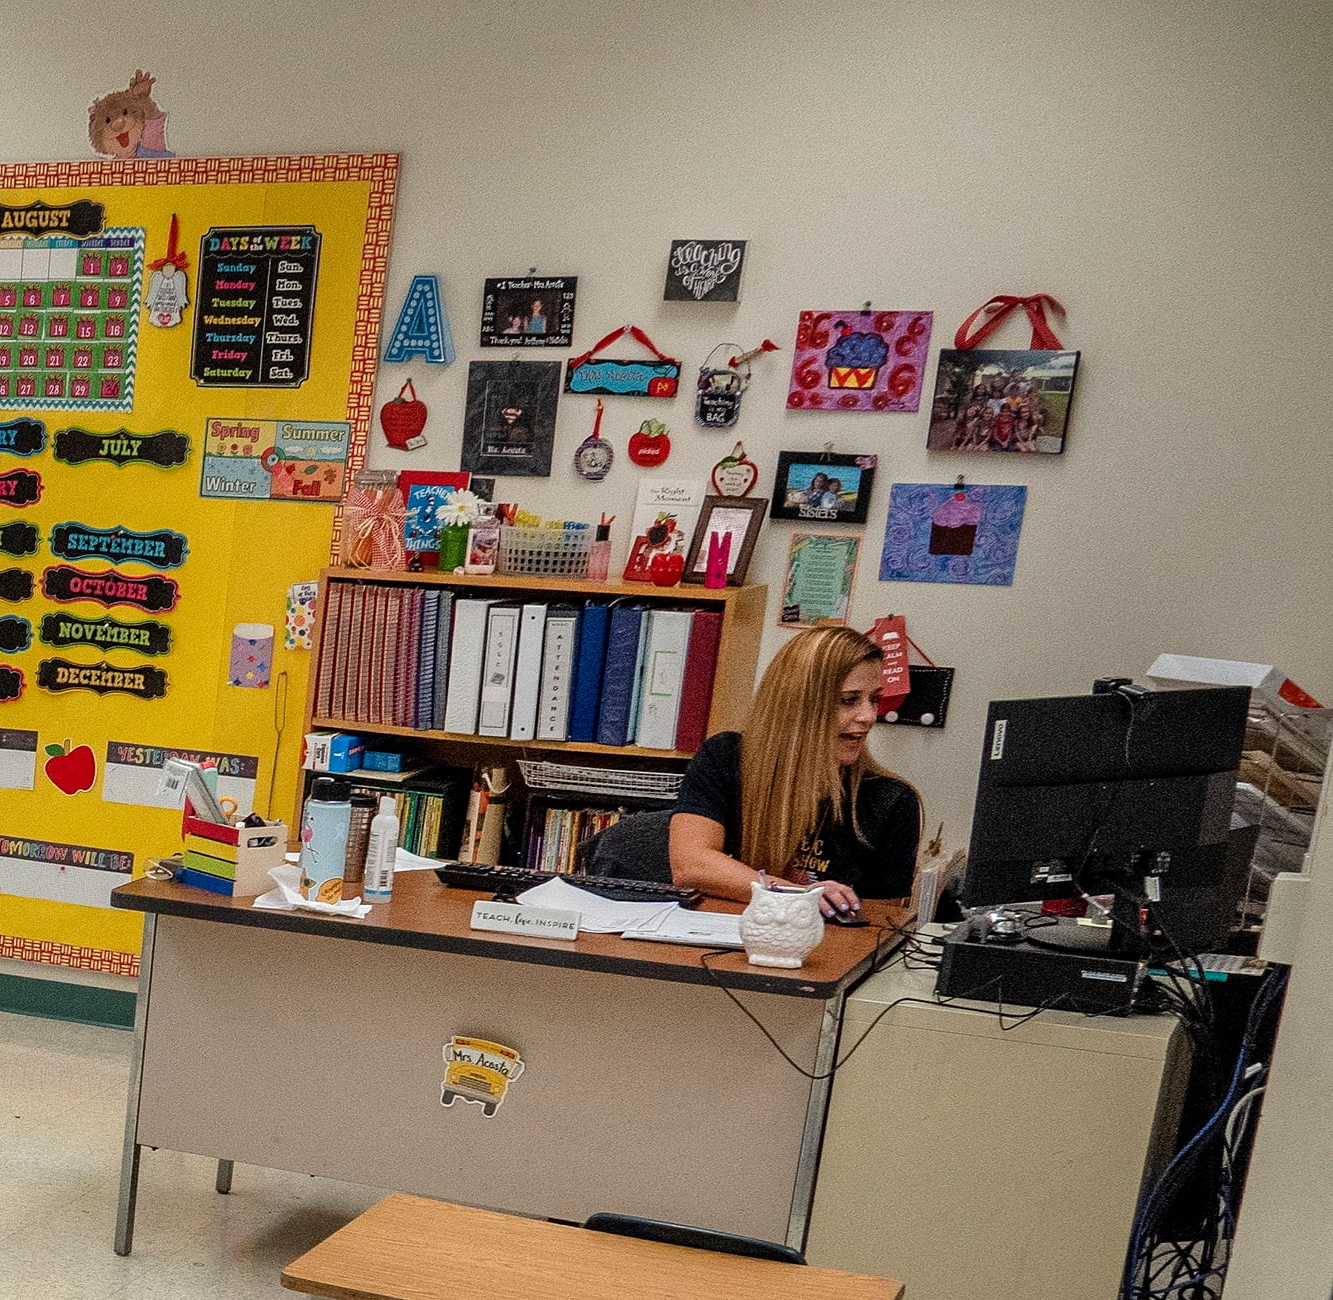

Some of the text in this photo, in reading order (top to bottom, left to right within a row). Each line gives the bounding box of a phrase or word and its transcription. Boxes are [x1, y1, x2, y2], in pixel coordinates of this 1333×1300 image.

[1, 210, 70, 228] AUGUST
[210, 237, 249, 250] DAYS
[265, 236, 313, 250] WEEK
[90, 263, 122, 274] 1 2
[217, 261, 303, 274] Sunday Sun.
[214, 279, 302, 291] Monday Mon.
[5, 295, 10, 305] 5
[29, 295, 35, 305] 6
[60, 294, 65, 304] 7
[87, 295, 93, 305] 8
[115, 295, 121, 305] 9
[212, 297, 302, 309] Tuesday Tues.
[203, 315, 299, 327] Wednesday Wed.
[384, 275, 447, 363] A
[24, 324, 34, 334] 13
[54, 325, 64, 335] 14
[81, 328, 91, 337] 15
[110, 326, 120, 336] 16
[206, 332, 303, 344] Thursday Thurs.
[24, 356, 35, 365] 20
[50, 356, 60, 366] 21
[77, 356, 89, 366] 22
[107, 356, 119, 366] 23
[212, 350, 294, 361] Friday Fri.
[203, 367, 293, 379] Saturday Sat.
[21, 384, 31, 394] 27
[49, 385, 60, 395] 28
[75, 385, 86, 395] 29
[211, 421, 260, 443] Spring
[282, 423, 345, 442] Summer
[99, 439, 142, 457] JULY
[205, 475, 256, 493] Winter
[292, 479, 321, 496] Fall
[660, 486, 685, 496] Right
[798, 505, 838, 520] sisters
[67, 533, 166, 558] SEPTEMBER
[405, 537, 442, 551] THINGS
[69, 577, 148, 601] OCTOBER
[58, 621, 151, 646] NOVEMBER
[884, 651, 903, 660] ALM
[56, 667, 145, 690] DECEMBER
[549, 634, 564, 732] ATTENDANCE
[887, 675, 900, 683] ON
[992, 723, 1005, 757] Lenovo
[73, 849, 106, 868] WILL
[535, 919, 576, 930] INSPIRE
[475, 1053, 509, 1076] Acosta
